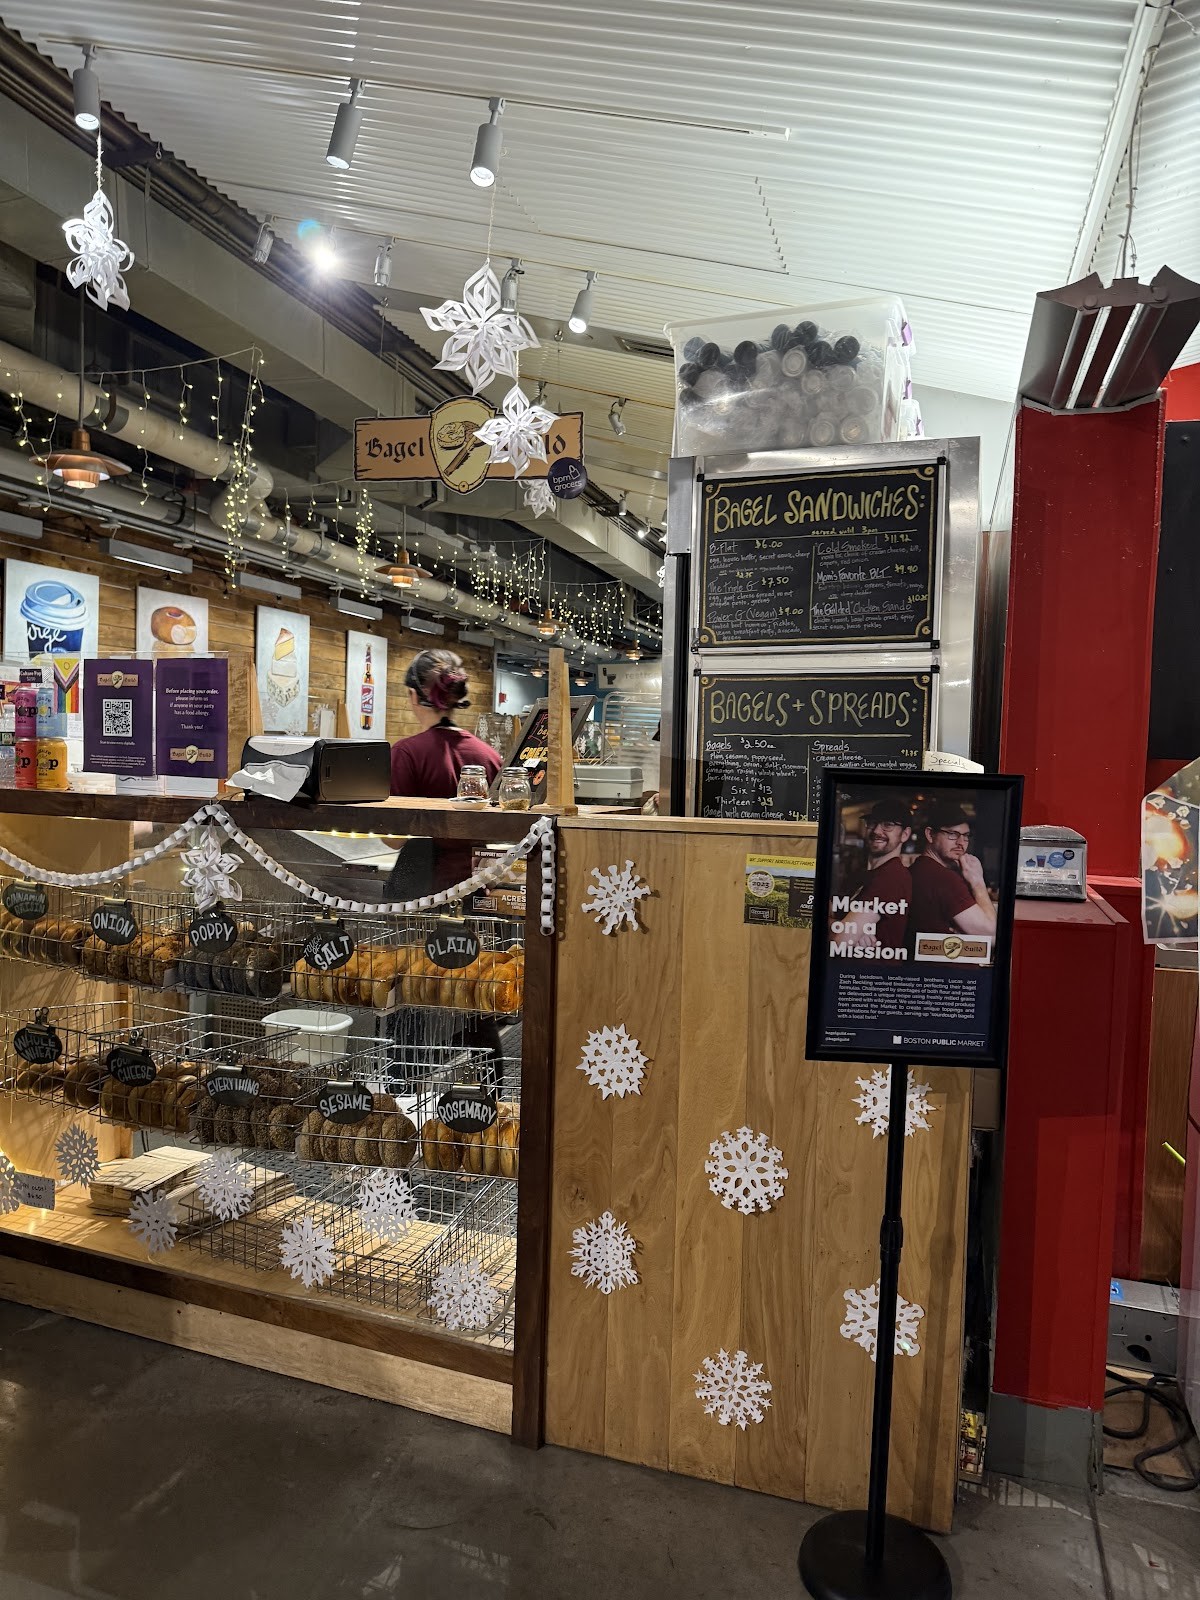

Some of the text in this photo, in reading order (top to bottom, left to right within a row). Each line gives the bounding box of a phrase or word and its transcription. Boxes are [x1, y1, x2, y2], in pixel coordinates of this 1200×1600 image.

[365, 437, 425, 463] Bagel
[552, 474, 571, 484] bpm
[554, 479, 583, 492] grocers
[713, 494, 777, 534] BAGEL
[861, 525, 878, 535] 3pm
[754, 539, 784, 549] $6.00
[869, 565, 891, 579] BLT
[761, 576, 790, 588] $7.50
[778, 606, 804, 616] $9.00
[710, 690, 790, 728] BAGELS
[706, 737, 732, 753] Bagels
[812, 739, 850, 755] Spreads
[730, 783, 773, 795] Six $13
[715, 795, 751, 807] Thirteen
[725, 806, 740, 818] with
[740, 810, 761, 819] cream
[520, 885, 527, 895] 5
[501, 894, 527, 903] ACRES
[807, 894, 815, 904] 8
[832, 895, 909, 915] Market
[93, 914, 135, 938] ONION
[830, 920, 877, 935] on a
[190, 922, 235, 947] POPPY
[314, 935, 350, 971] SALT
[427, 936, 478, 960] PLAIN
[829, 940, 908, 961] Mission
[903, 1037, 985, 1047] BOSTON PUBLIC MARKET
[117, 1064, 154, 1083] CHEESE
[206, 1077, 261, 1096] EVERYTHING
[319, 1093, 373, 1118] SESAME
[438, 1099, 497, 1125] ROSEMARY
